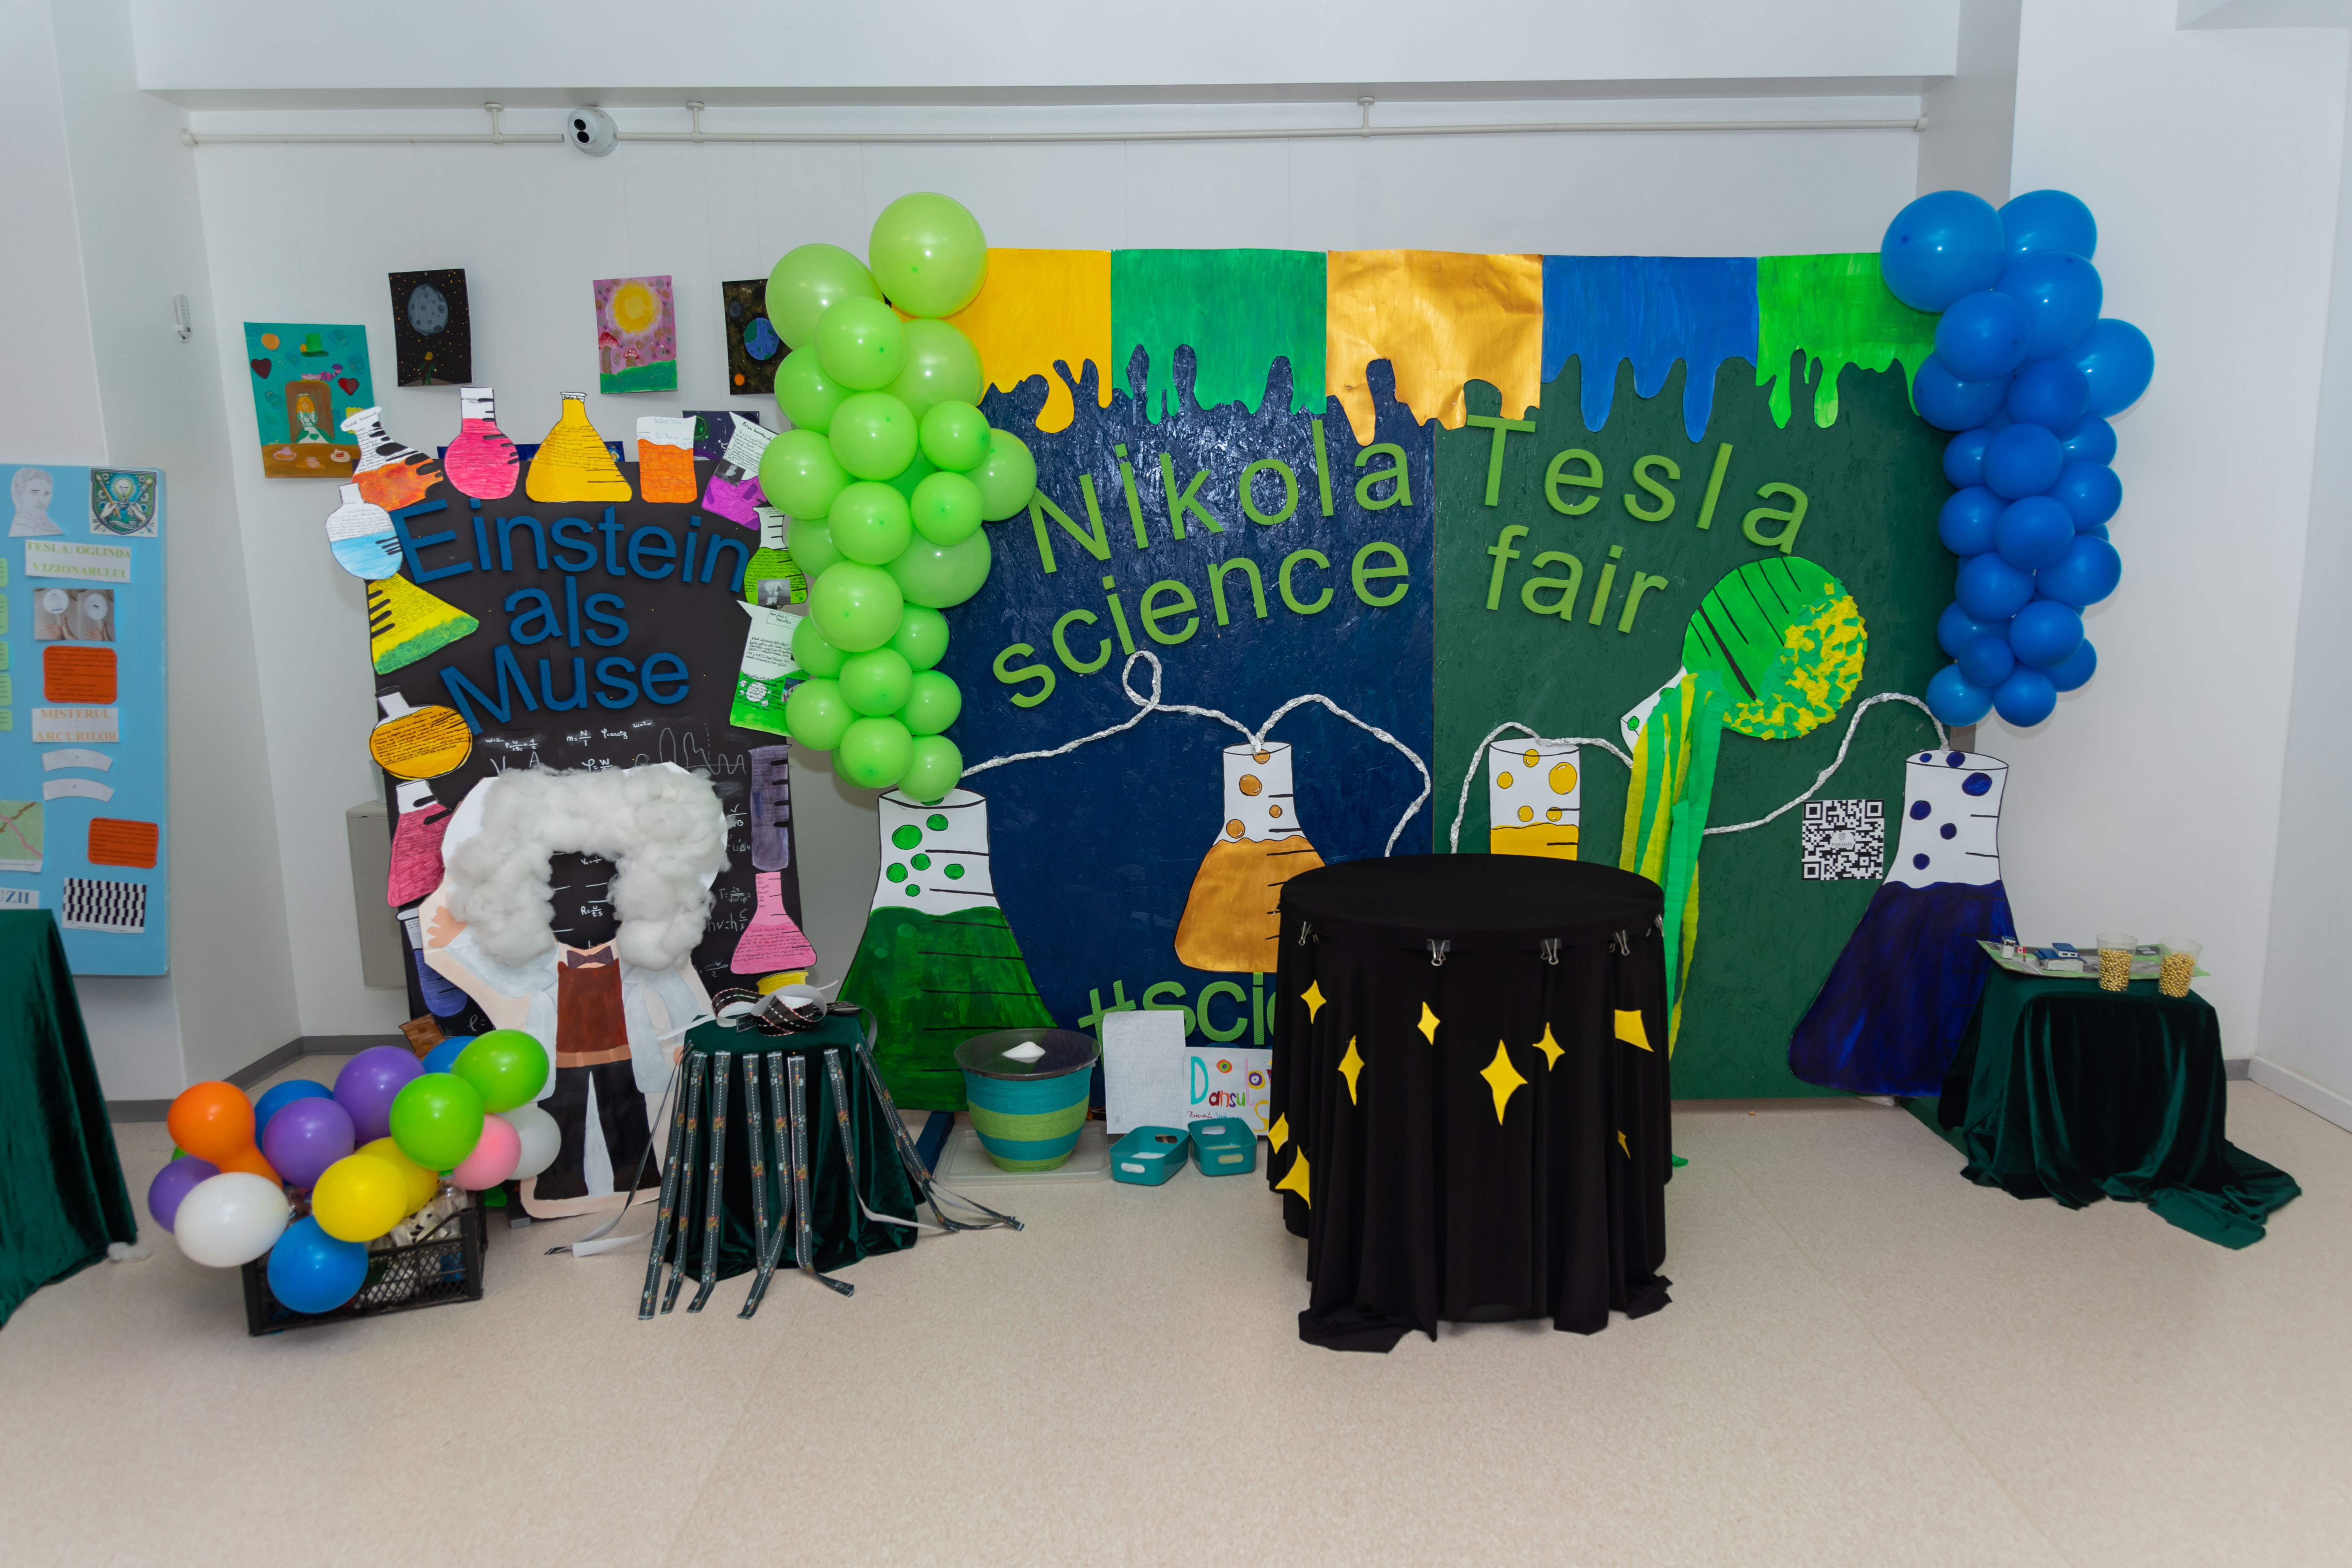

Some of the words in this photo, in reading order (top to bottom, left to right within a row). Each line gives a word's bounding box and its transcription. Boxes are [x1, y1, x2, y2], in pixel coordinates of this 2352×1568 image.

[1029, 420, 1413, 574] Nikola
[1467, 415, 1808, 555] Tesla
[26, 542, 73, 553] TESLA:
[76, 546, 131, 559] OGLINDA
[33, 562, 126, 578] VIZIONARULUI
[388, 498, 749, 592] Einstein
[504, 576, 629, 648] als
[992, 541, 1410, 708] science
[1486, 525, 1669, 633] fair
[41, 709, 111, 719] MISTERUL
[439, 643, 690, 736] Muse
[36, 731, 118, 742] ARCURILOR
[1078, 971, 1276, 1073] #sci
[1191, 1056, 1255, 1108] Dansul
